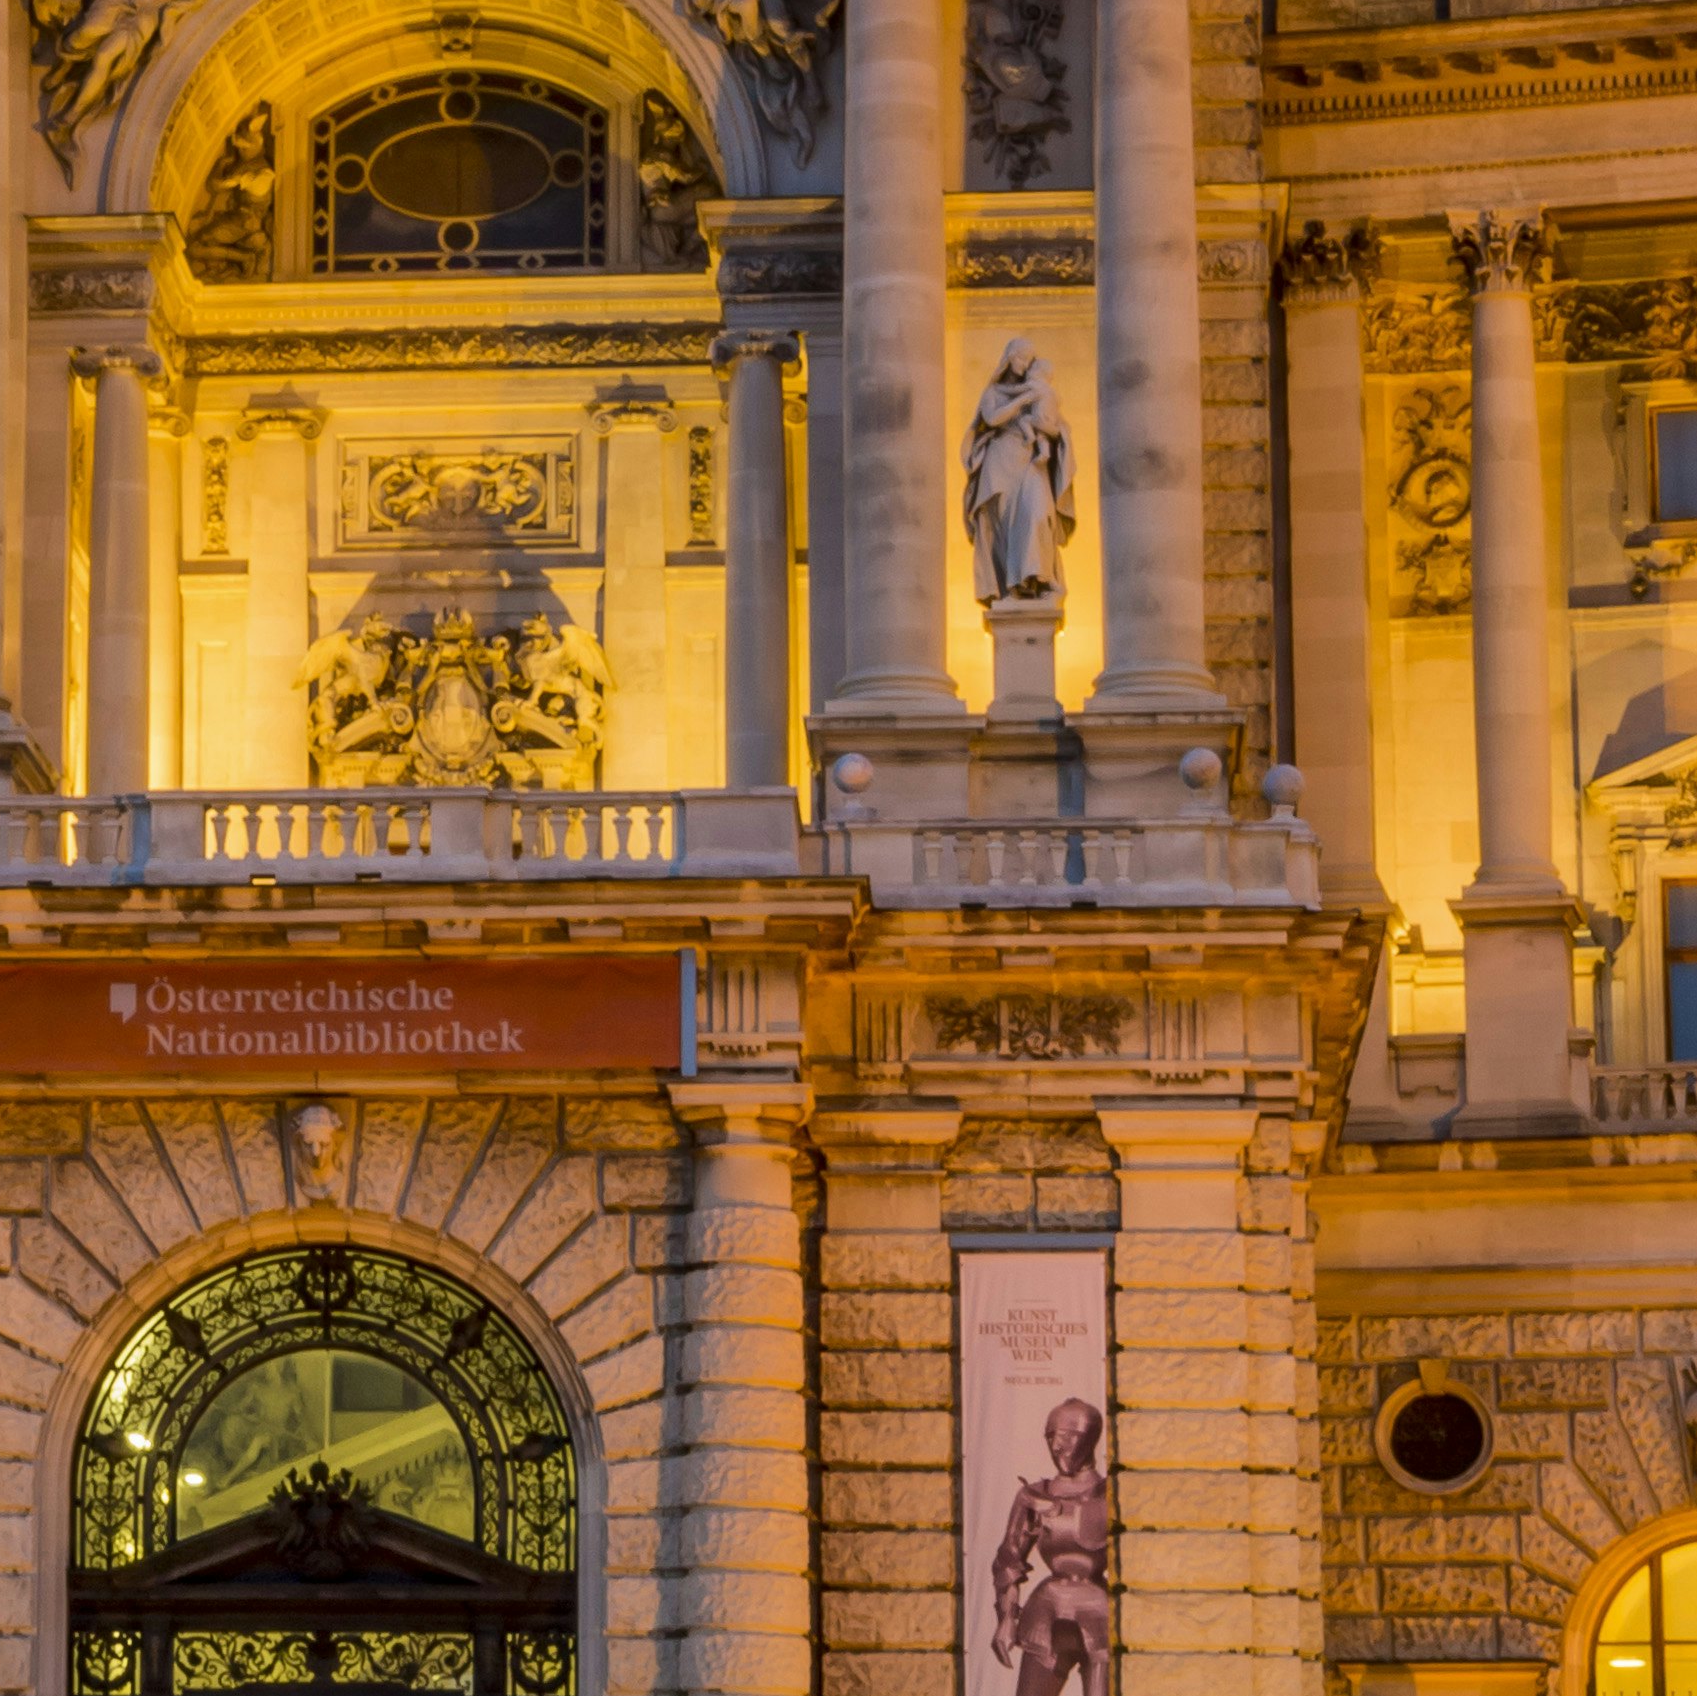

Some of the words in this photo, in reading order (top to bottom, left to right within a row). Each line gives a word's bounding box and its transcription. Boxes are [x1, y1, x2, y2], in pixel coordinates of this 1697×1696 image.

[146, 977, 454, 1016] Österreichische
[146, 1020, 525, 1057] Nationalbibliothek
[1008, 1310, 1058, 1321] KUNST
[979, 1323, 1088, 1335] HISTORISCHES
[1001, 1337, 1066, 1348] MUSEUM
[1012, 1351, 1053, 1361] WIEN
